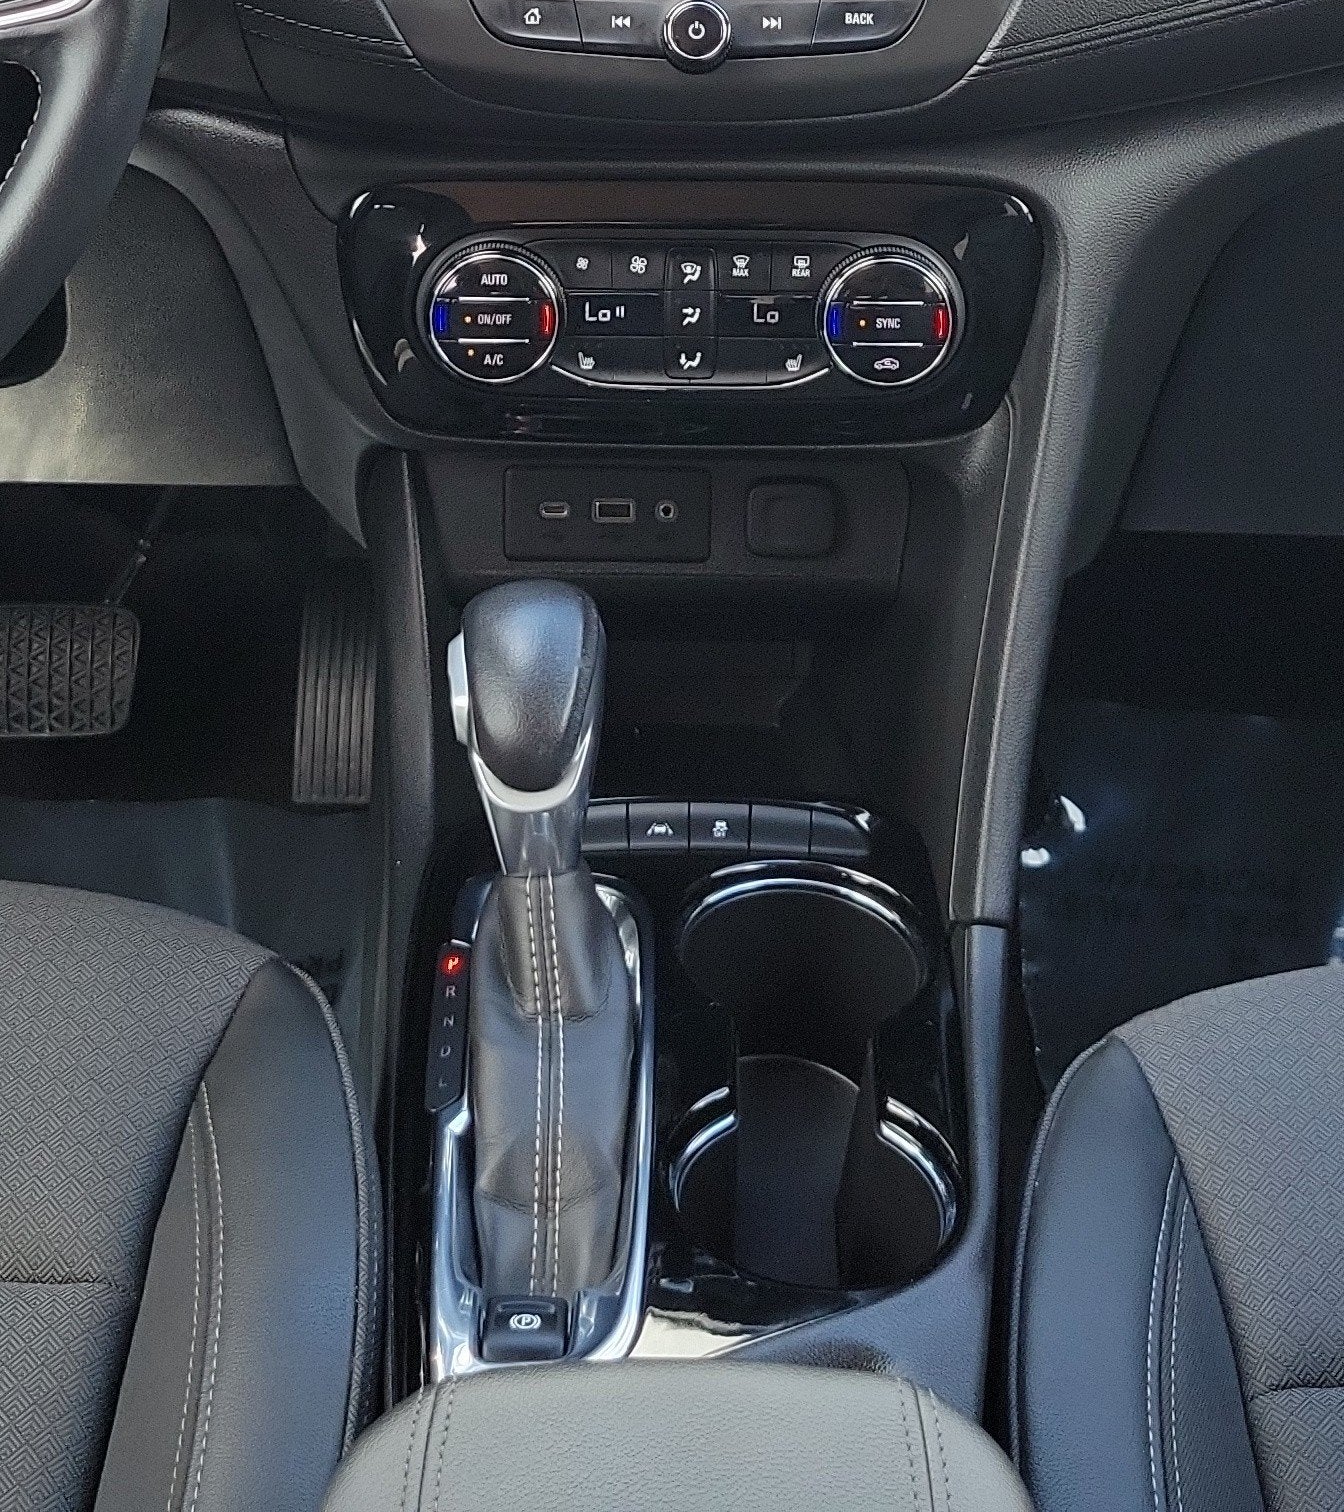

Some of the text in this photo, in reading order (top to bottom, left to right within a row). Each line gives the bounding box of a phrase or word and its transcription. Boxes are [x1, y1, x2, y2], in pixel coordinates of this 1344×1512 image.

[844, 12, 875, 25] BACK
[732, 267, 750, 277] MAX
[791, 268, 811, 278] REAR
[480, 273, 508, 285] AUTO
[477, 313, 513, 325] ON/OFF
[875, 317, 902, 329] SYNC
[483, 353, 504, 366] A/C
[445, 985, 456, 998] R
[443, 1015, 455, 1028] N
